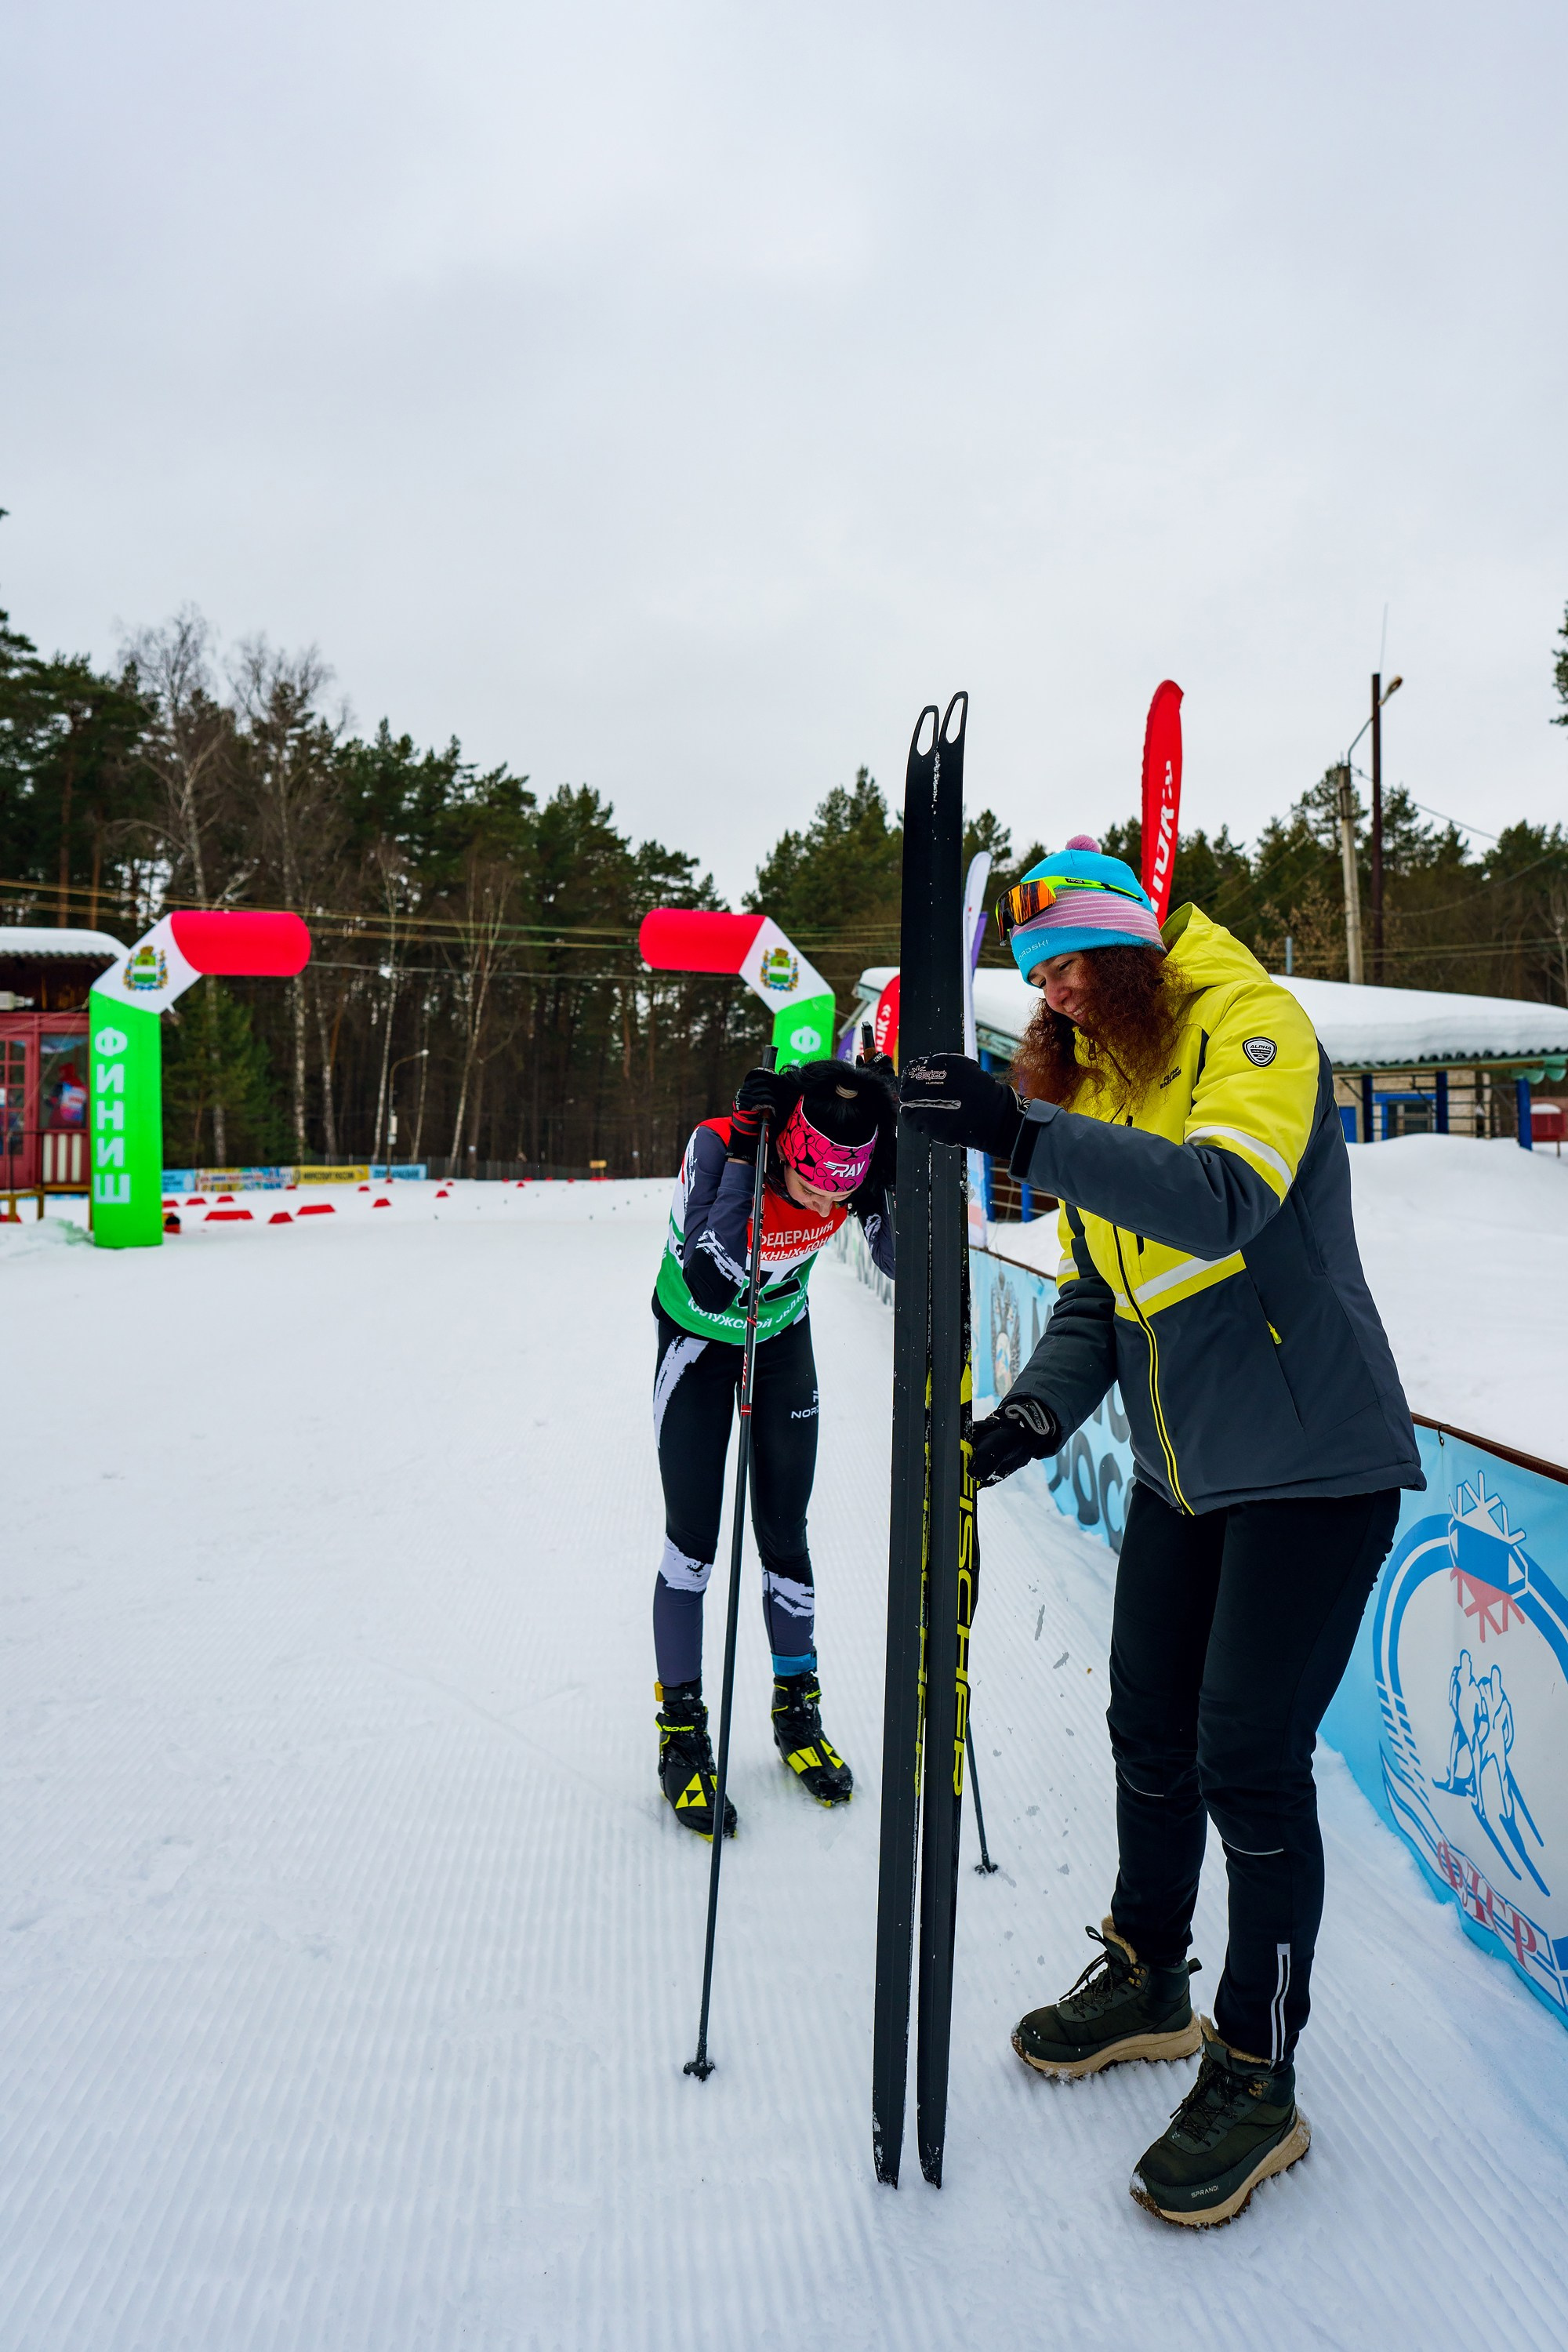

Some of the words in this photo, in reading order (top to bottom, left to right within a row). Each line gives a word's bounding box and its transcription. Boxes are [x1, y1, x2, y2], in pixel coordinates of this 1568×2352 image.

[1018, 939, 1049, 963] ORDSKI
[94, 1026, 131, 1204] ФИНИШ
[829, 1160, 866, 1178] RAY
[953, 1440, 977, 1796] FISCHER
[1191, 2185, 1218, 2198] SPRANDI
